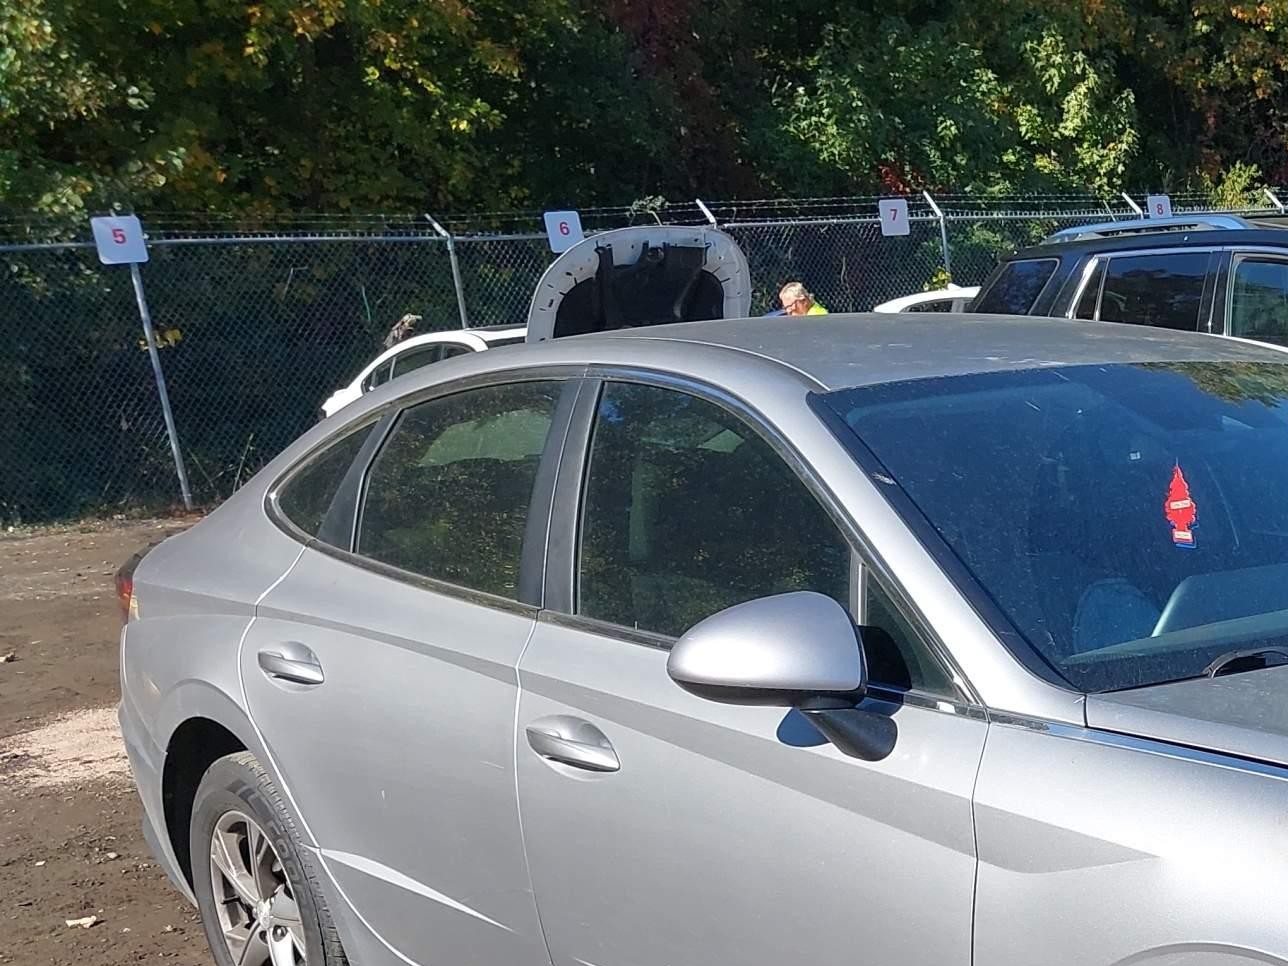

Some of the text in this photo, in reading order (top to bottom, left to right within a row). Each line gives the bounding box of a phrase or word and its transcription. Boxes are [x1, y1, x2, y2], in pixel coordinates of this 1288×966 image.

[890, 208, 898, 221] 7
[1156, 203, 1164, 215] 8
[559, 221, 570, 236] 6
[111, 228, 127, 244] 5
